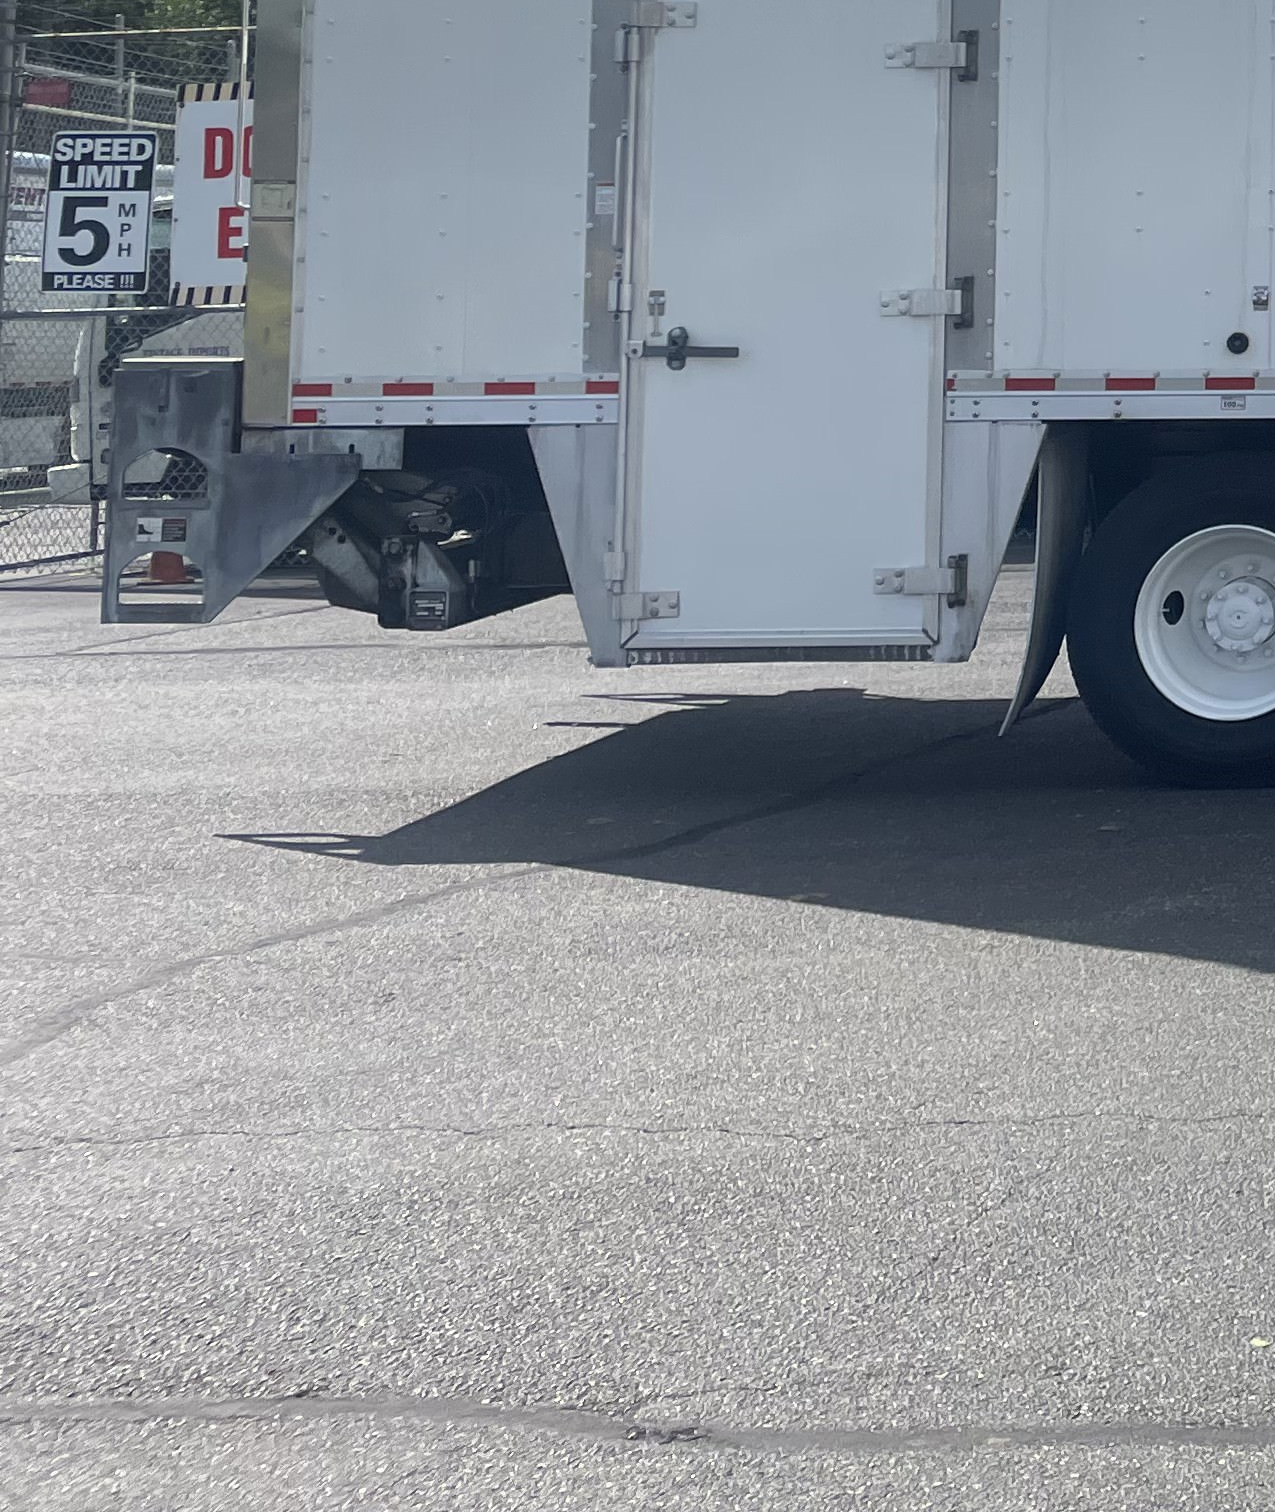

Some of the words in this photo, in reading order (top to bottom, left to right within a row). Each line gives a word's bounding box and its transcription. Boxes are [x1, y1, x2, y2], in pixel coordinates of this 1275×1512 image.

[54, 138, 154, 162] SPEED
[59, 164, 143, 189] LIMIT
[58, 196, 110, 267] 5
[53, 274, 114, 289] PLEASE
